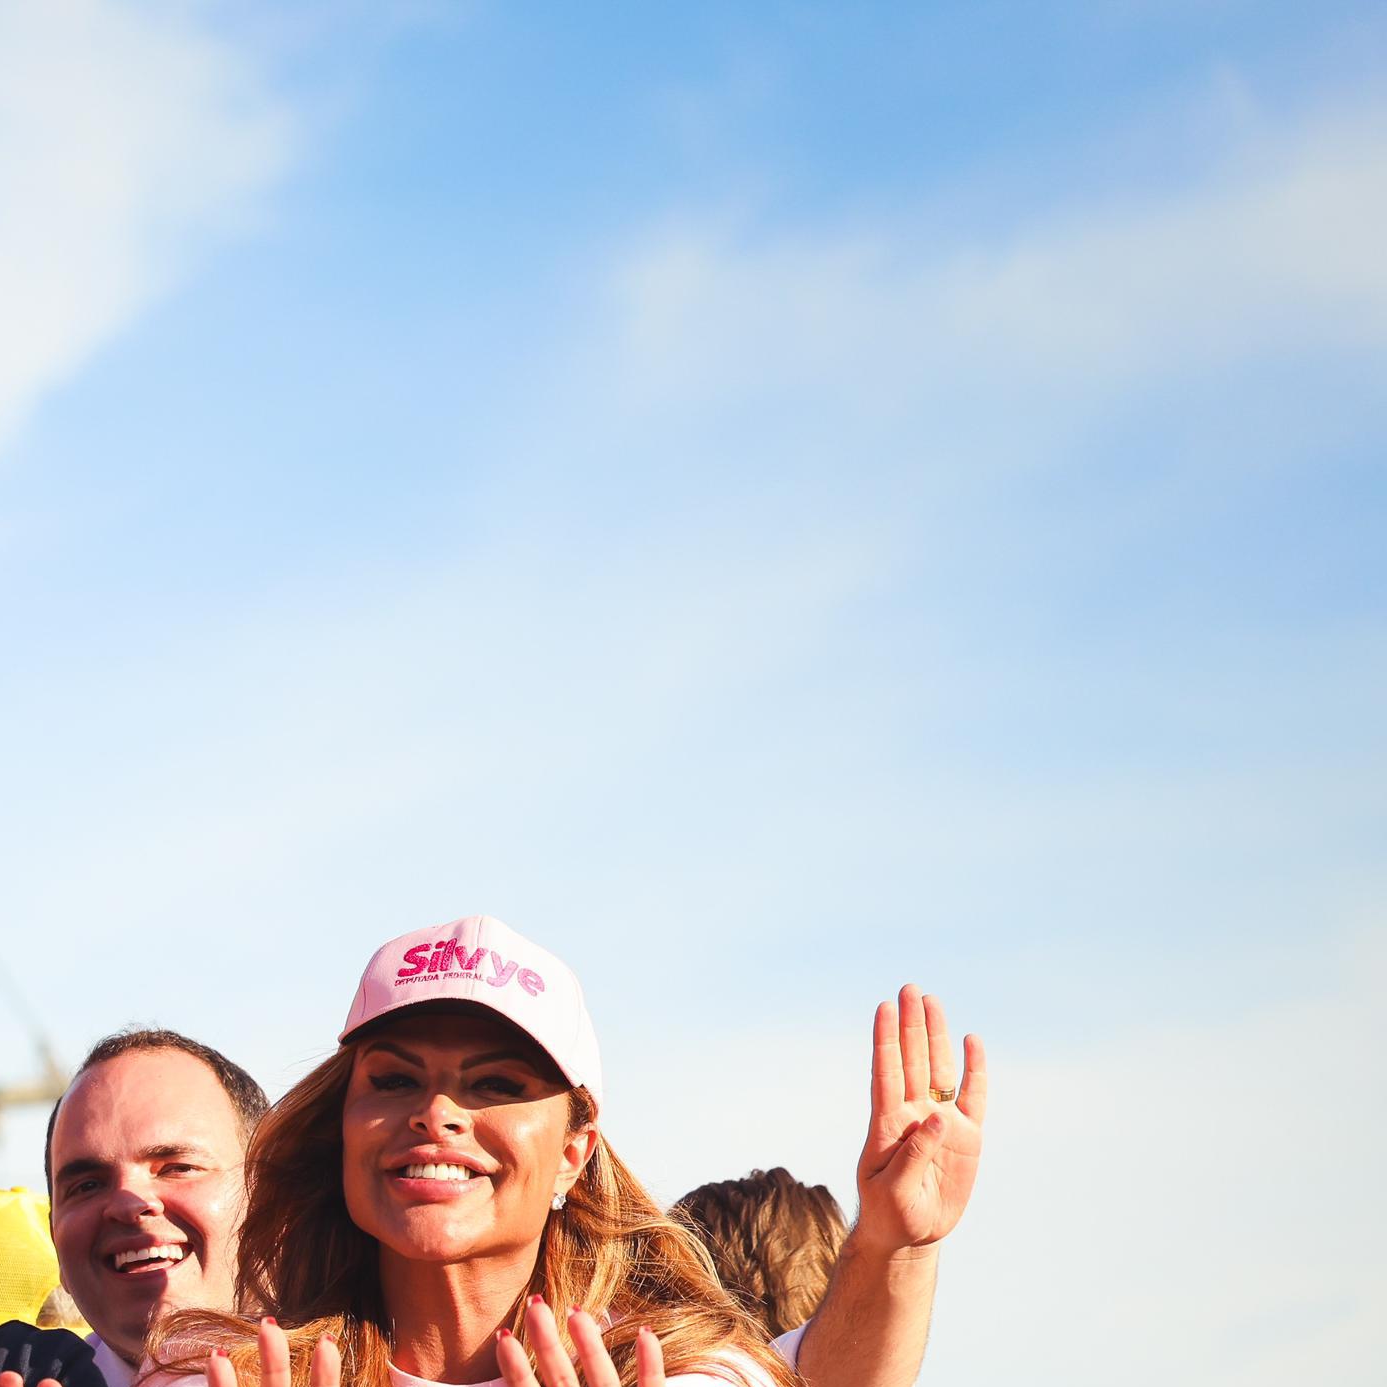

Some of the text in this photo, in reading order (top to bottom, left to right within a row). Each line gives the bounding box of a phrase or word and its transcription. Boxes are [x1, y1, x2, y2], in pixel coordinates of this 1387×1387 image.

[394, 971, 484, 986] DEPUTADA FEDERAL
[397, 937, 545, 997] Silvye
